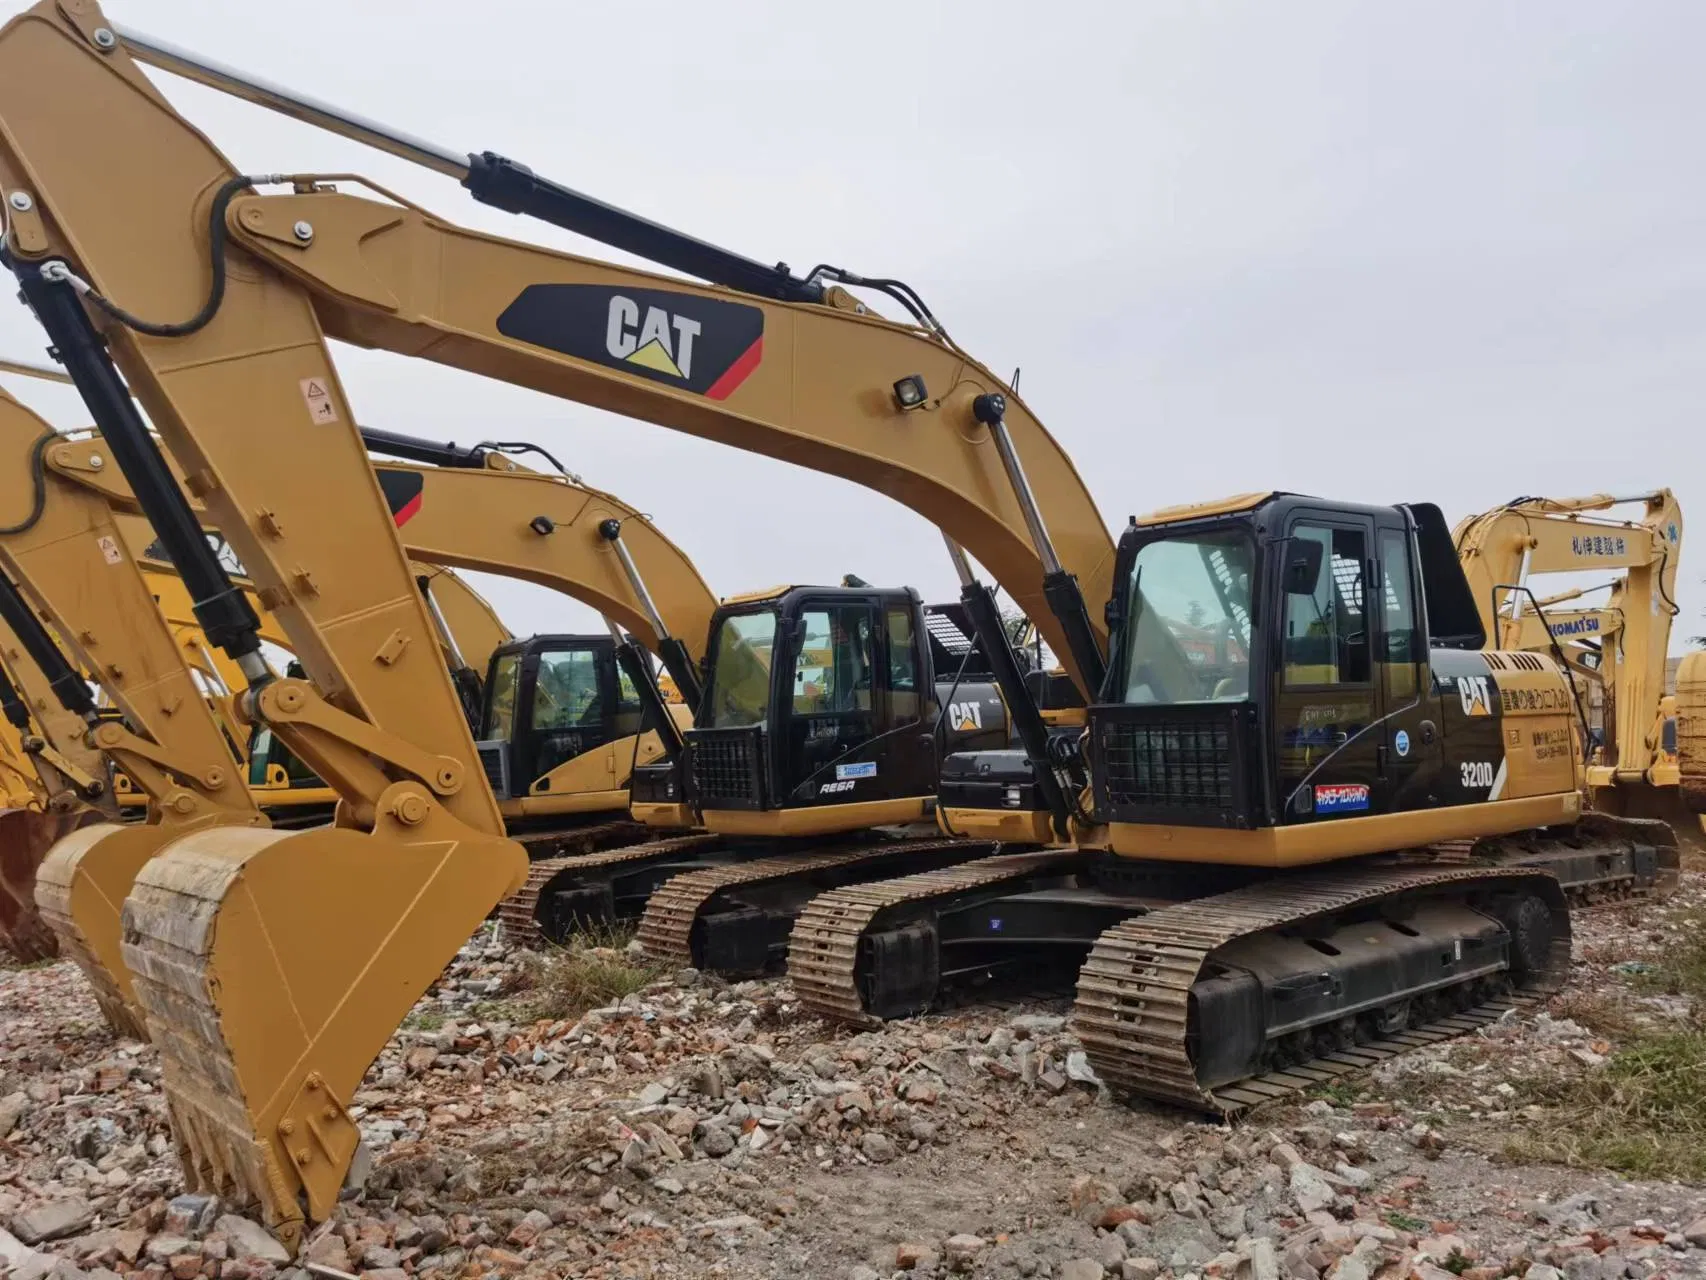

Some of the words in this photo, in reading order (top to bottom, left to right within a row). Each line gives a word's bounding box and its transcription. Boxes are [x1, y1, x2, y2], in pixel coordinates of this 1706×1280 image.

[606, 295, 701, 380] CAT
[1548, 616, 1599, 637] KOMATSU
[1457, 677, 1492, 716] CAT
[949, 701, 982, 731] CAT
[820, 780, 856, 794] REGA
[1461, 762, 1493, 787] 320D
